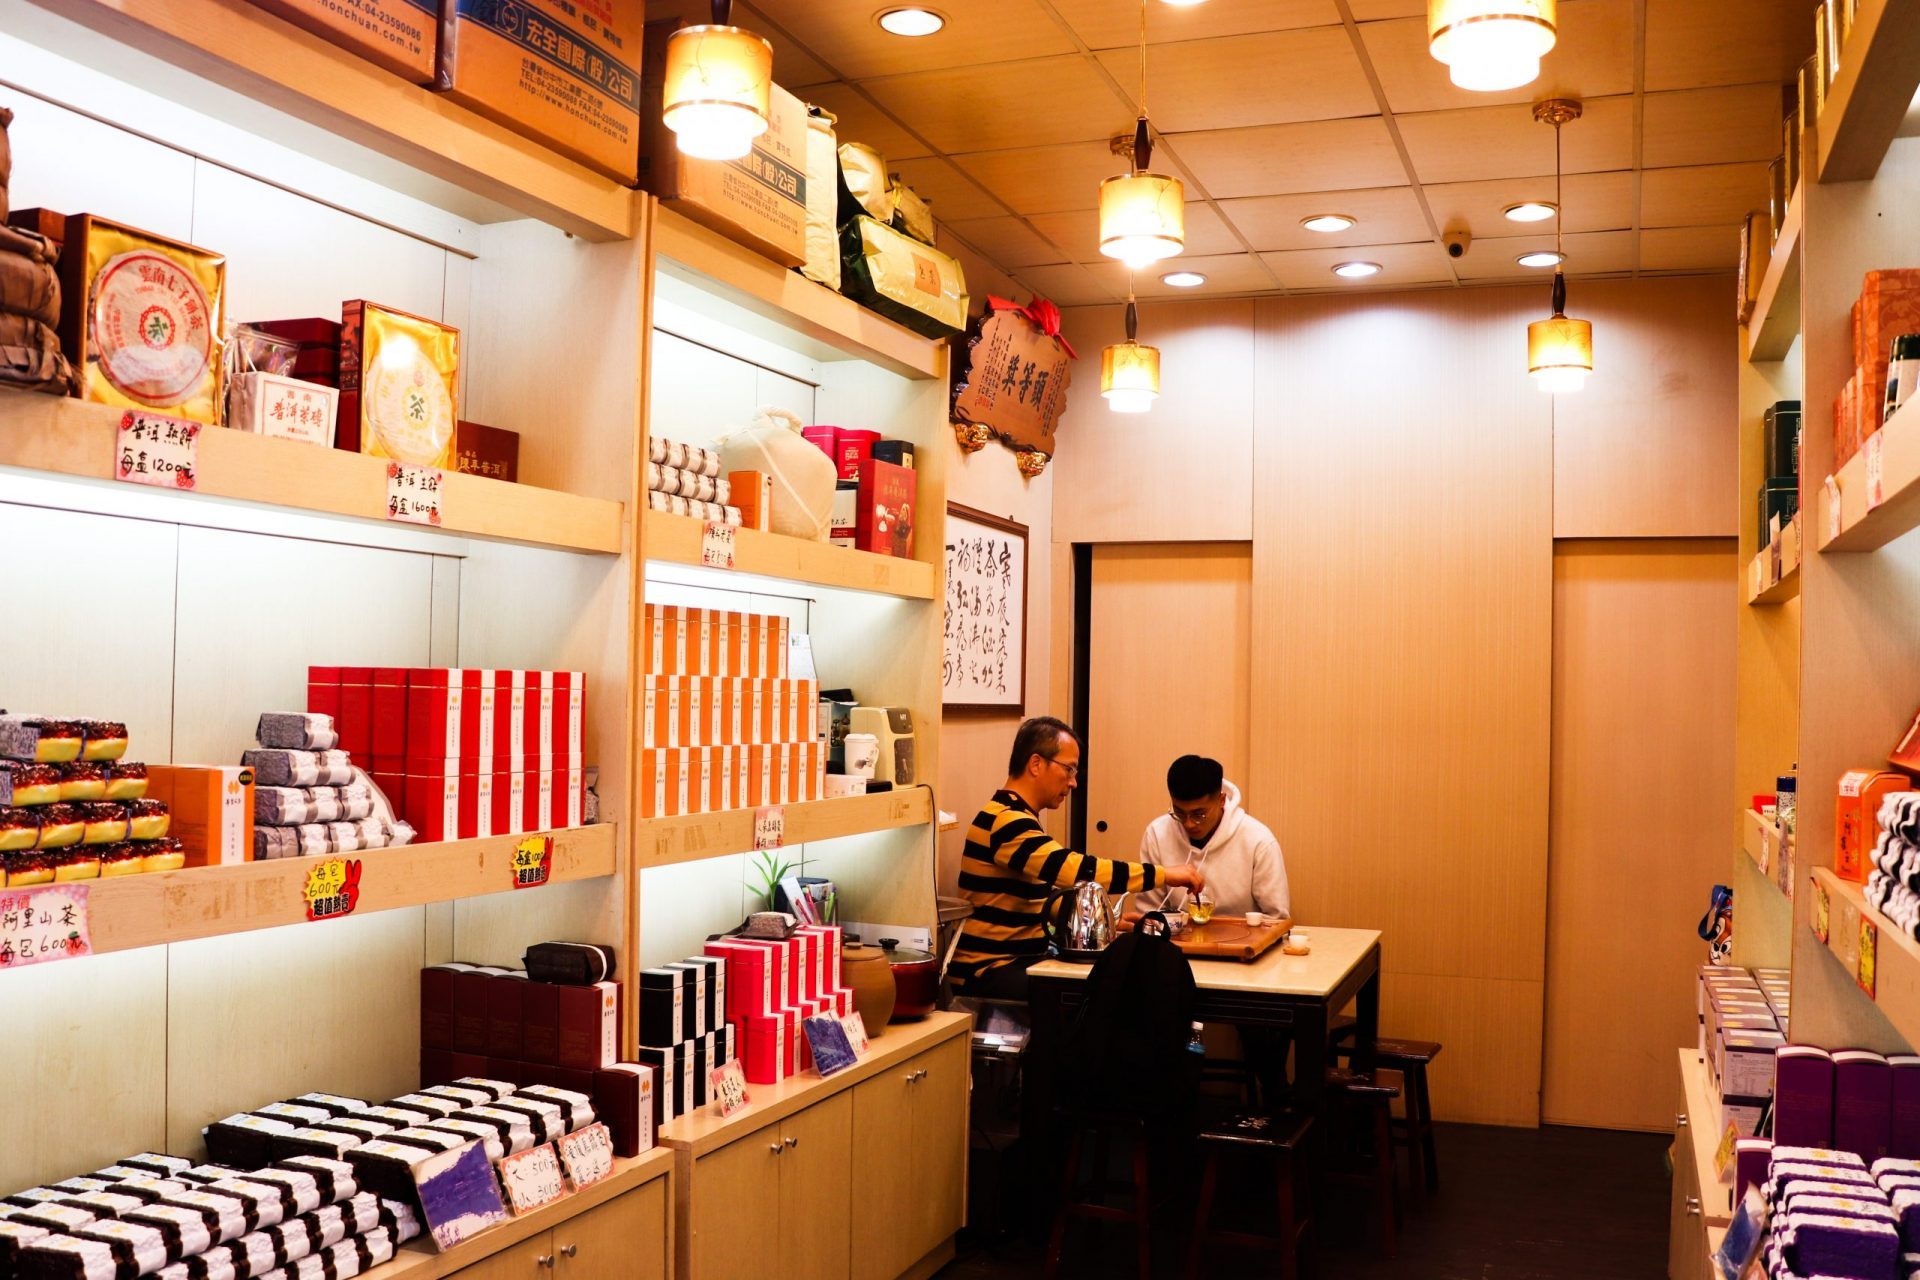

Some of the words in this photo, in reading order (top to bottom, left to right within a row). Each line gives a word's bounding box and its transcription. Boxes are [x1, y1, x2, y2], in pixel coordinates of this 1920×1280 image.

[410, 394, 425, 421] 茶
[2, 904, 77, 931] 阿里山茶
